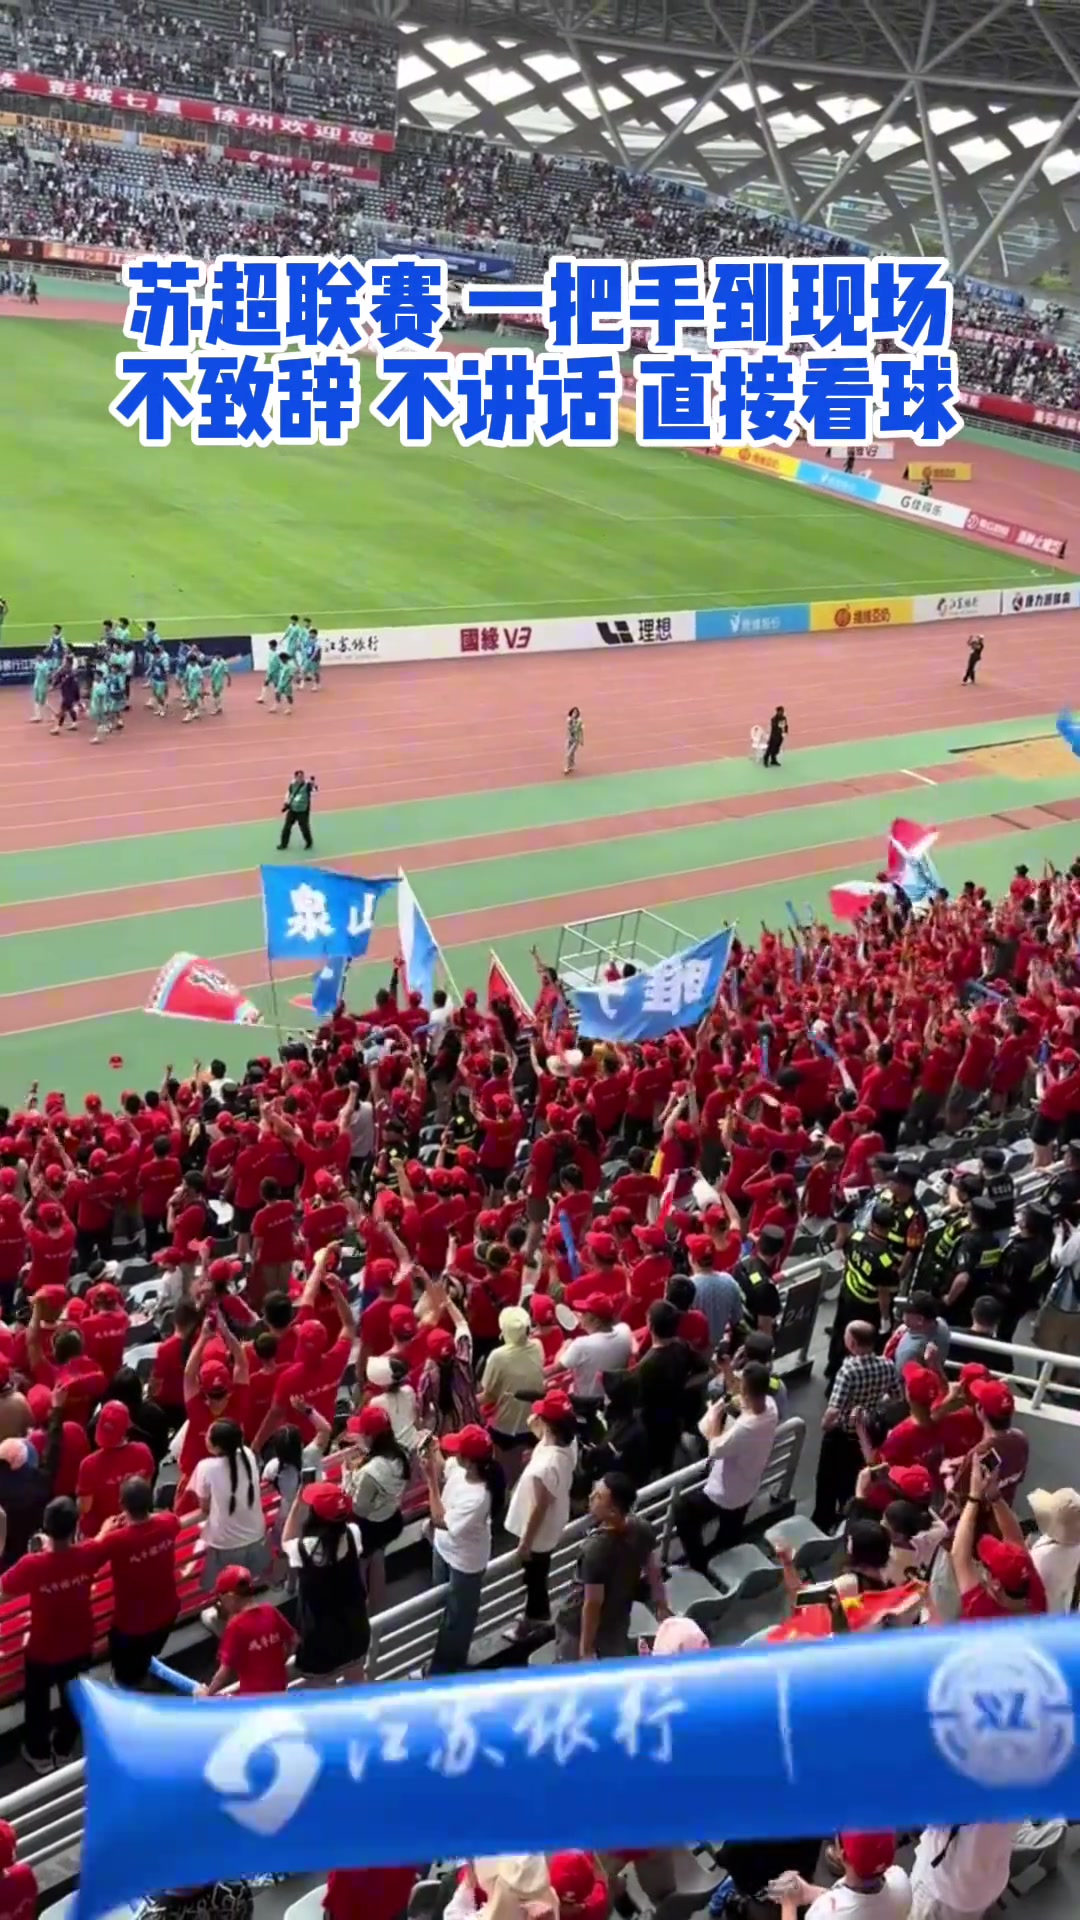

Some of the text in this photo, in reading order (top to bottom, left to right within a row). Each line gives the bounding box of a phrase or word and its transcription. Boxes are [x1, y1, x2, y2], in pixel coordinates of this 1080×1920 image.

[212, 106, 375, 146] 徐州欢迎您
[504, 627, 532, 649] V3
[638, 617, 673, 642] 理想
[346, 1680, 687, 1783] 江苏银行
